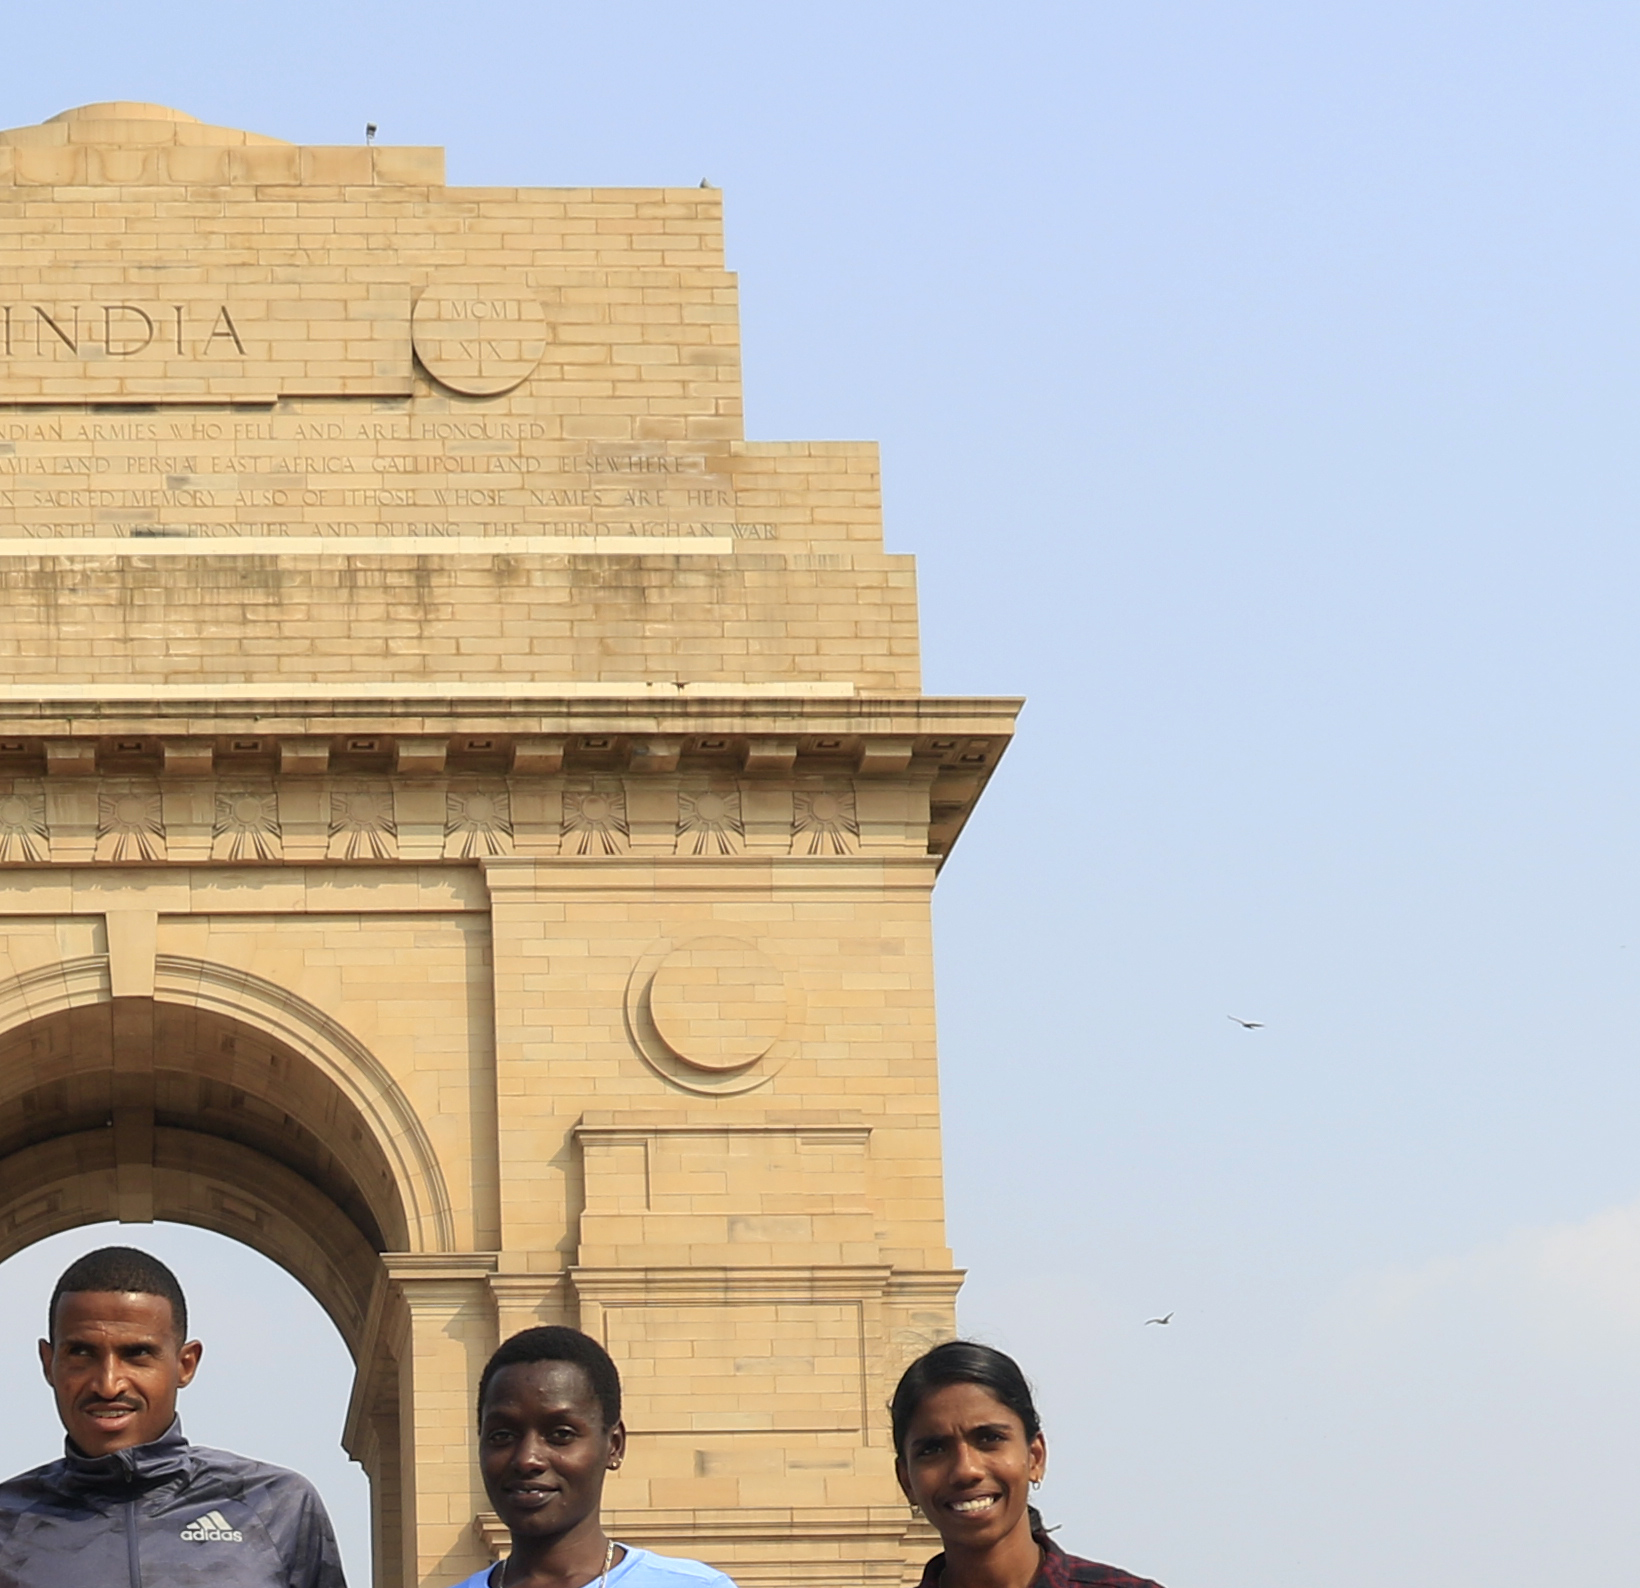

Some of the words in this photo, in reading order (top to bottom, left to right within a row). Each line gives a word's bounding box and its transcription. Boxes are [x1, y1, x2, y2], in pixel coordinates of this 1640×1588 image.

[451, 301, 508, 319] MCM
[2, 305, 247, 356] INDIA
[458, 341, 502, 360] XIX
[78, 425, 157, 441] ARMIES
[170, 424, 222, 440] WHO
[234, 424, 274, 440] FELL
[294, 424, 343, 440] AND
[356, 424, 399, 440] ARE
[422, 423, 545, 440] HONOURED
[62, 458, 110, 474] AND
[127, 458, 194, 474] PERSIA
[212, 458, 260, 474] EAST
[278, 457, 356, 473] AFRICA
[372, 457, 476, 473] GALLIPOLI
[492, 457, 541, 473] AND
[561, 456, 684, 472] ELSEWHERE
[33, 491, 114, 508] SACRED
[131, 491, 216, 507] MEMORY
[235, 491, 289, 507] ALSO
[302, 491, 328, 507] OF
[346, 490, 415, 507] THOSE
[432, 490, 507, 506] WHOSE
[528, 489, 603, 506] NAMES
[623, 489, 664, 506] ARE
[687, 489, 742, 505] HERE
[22, 525, 95, 539] NORTH
[187, 524, 290, 538] FRONTIER
[311, 524, 359, 538] AND
[374, 523, 460, 538] DURING
[481, 523, 519, 537] THE
[540, 522, 610, 537] THIRD
[730, 524, 777, 540] WAR
[180, 1529, 242, 1542] adidas
